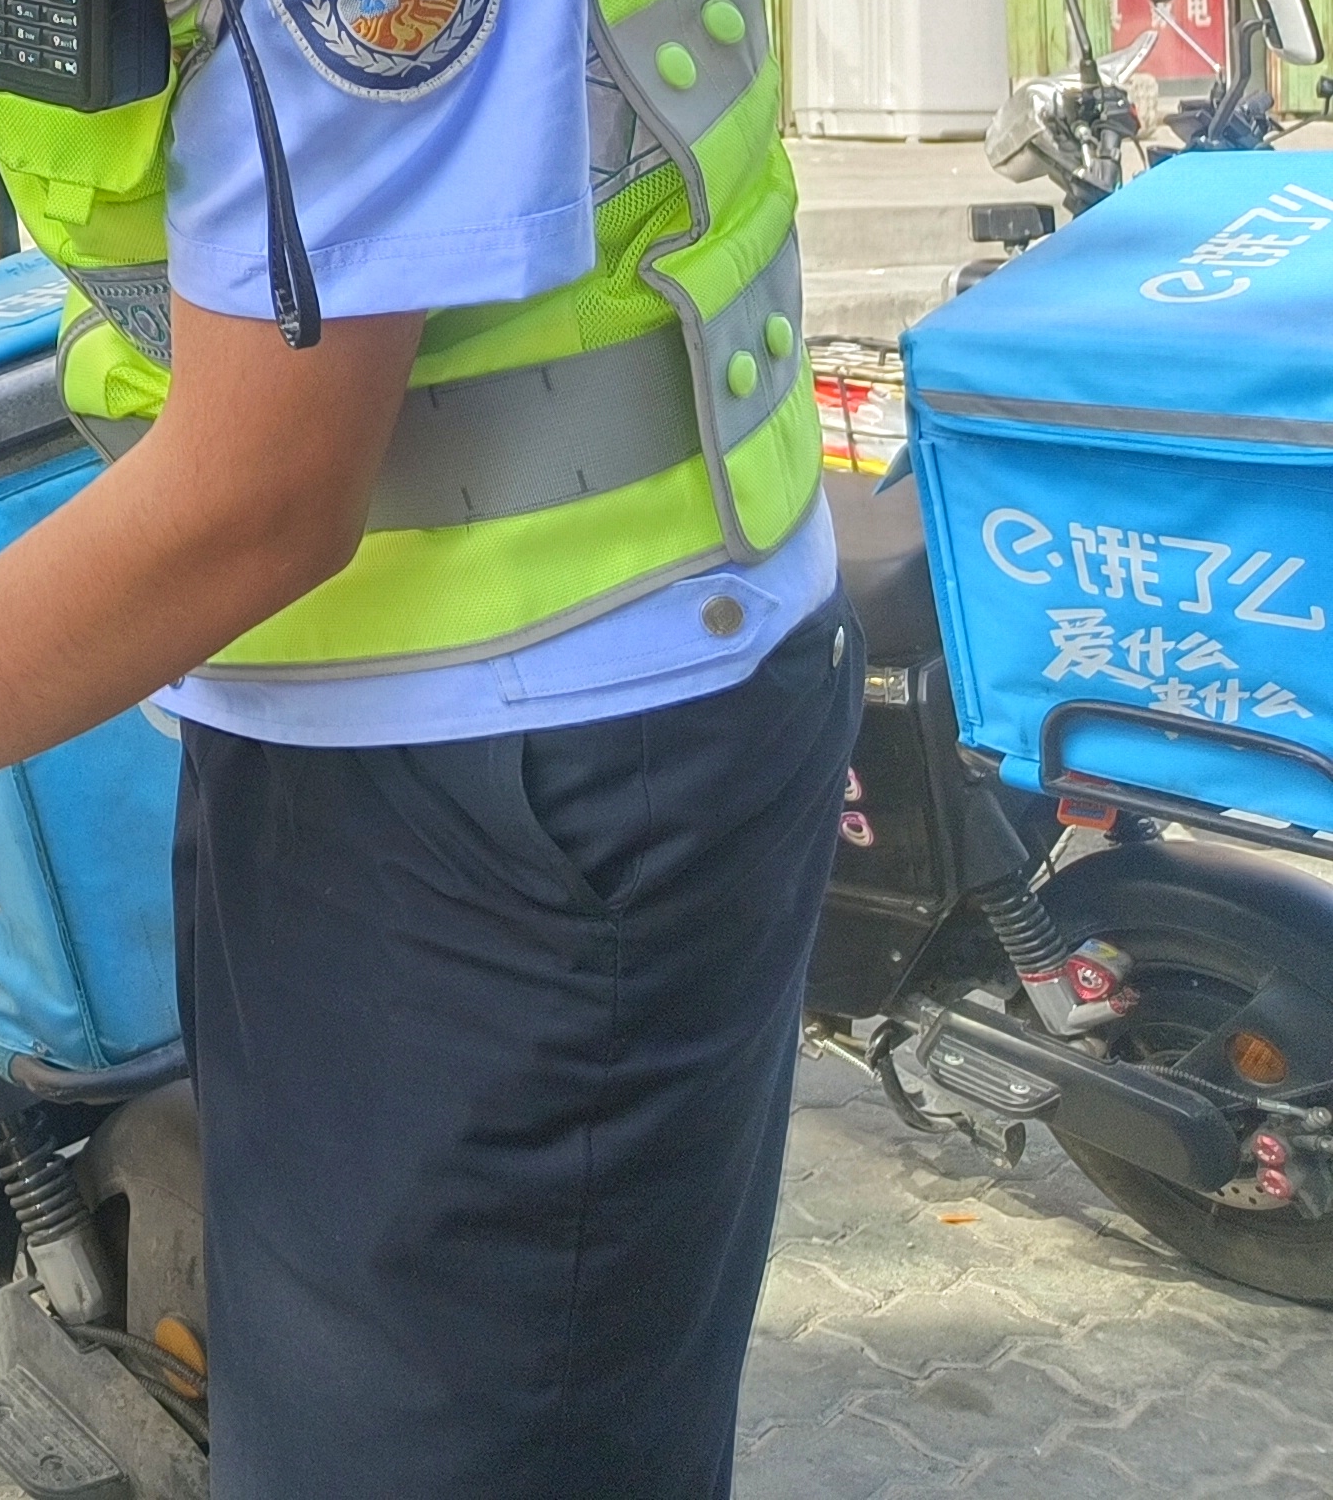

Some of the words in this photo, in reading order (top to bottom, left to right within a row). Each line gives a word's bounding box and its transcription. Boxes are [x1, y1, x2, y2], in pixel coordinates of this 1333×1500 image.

[1068, 521, 1326, 631] 饿了么
[1041, 607, 1240, 690] 爱什么
[1148, 676, 1315, 725] 来什么
